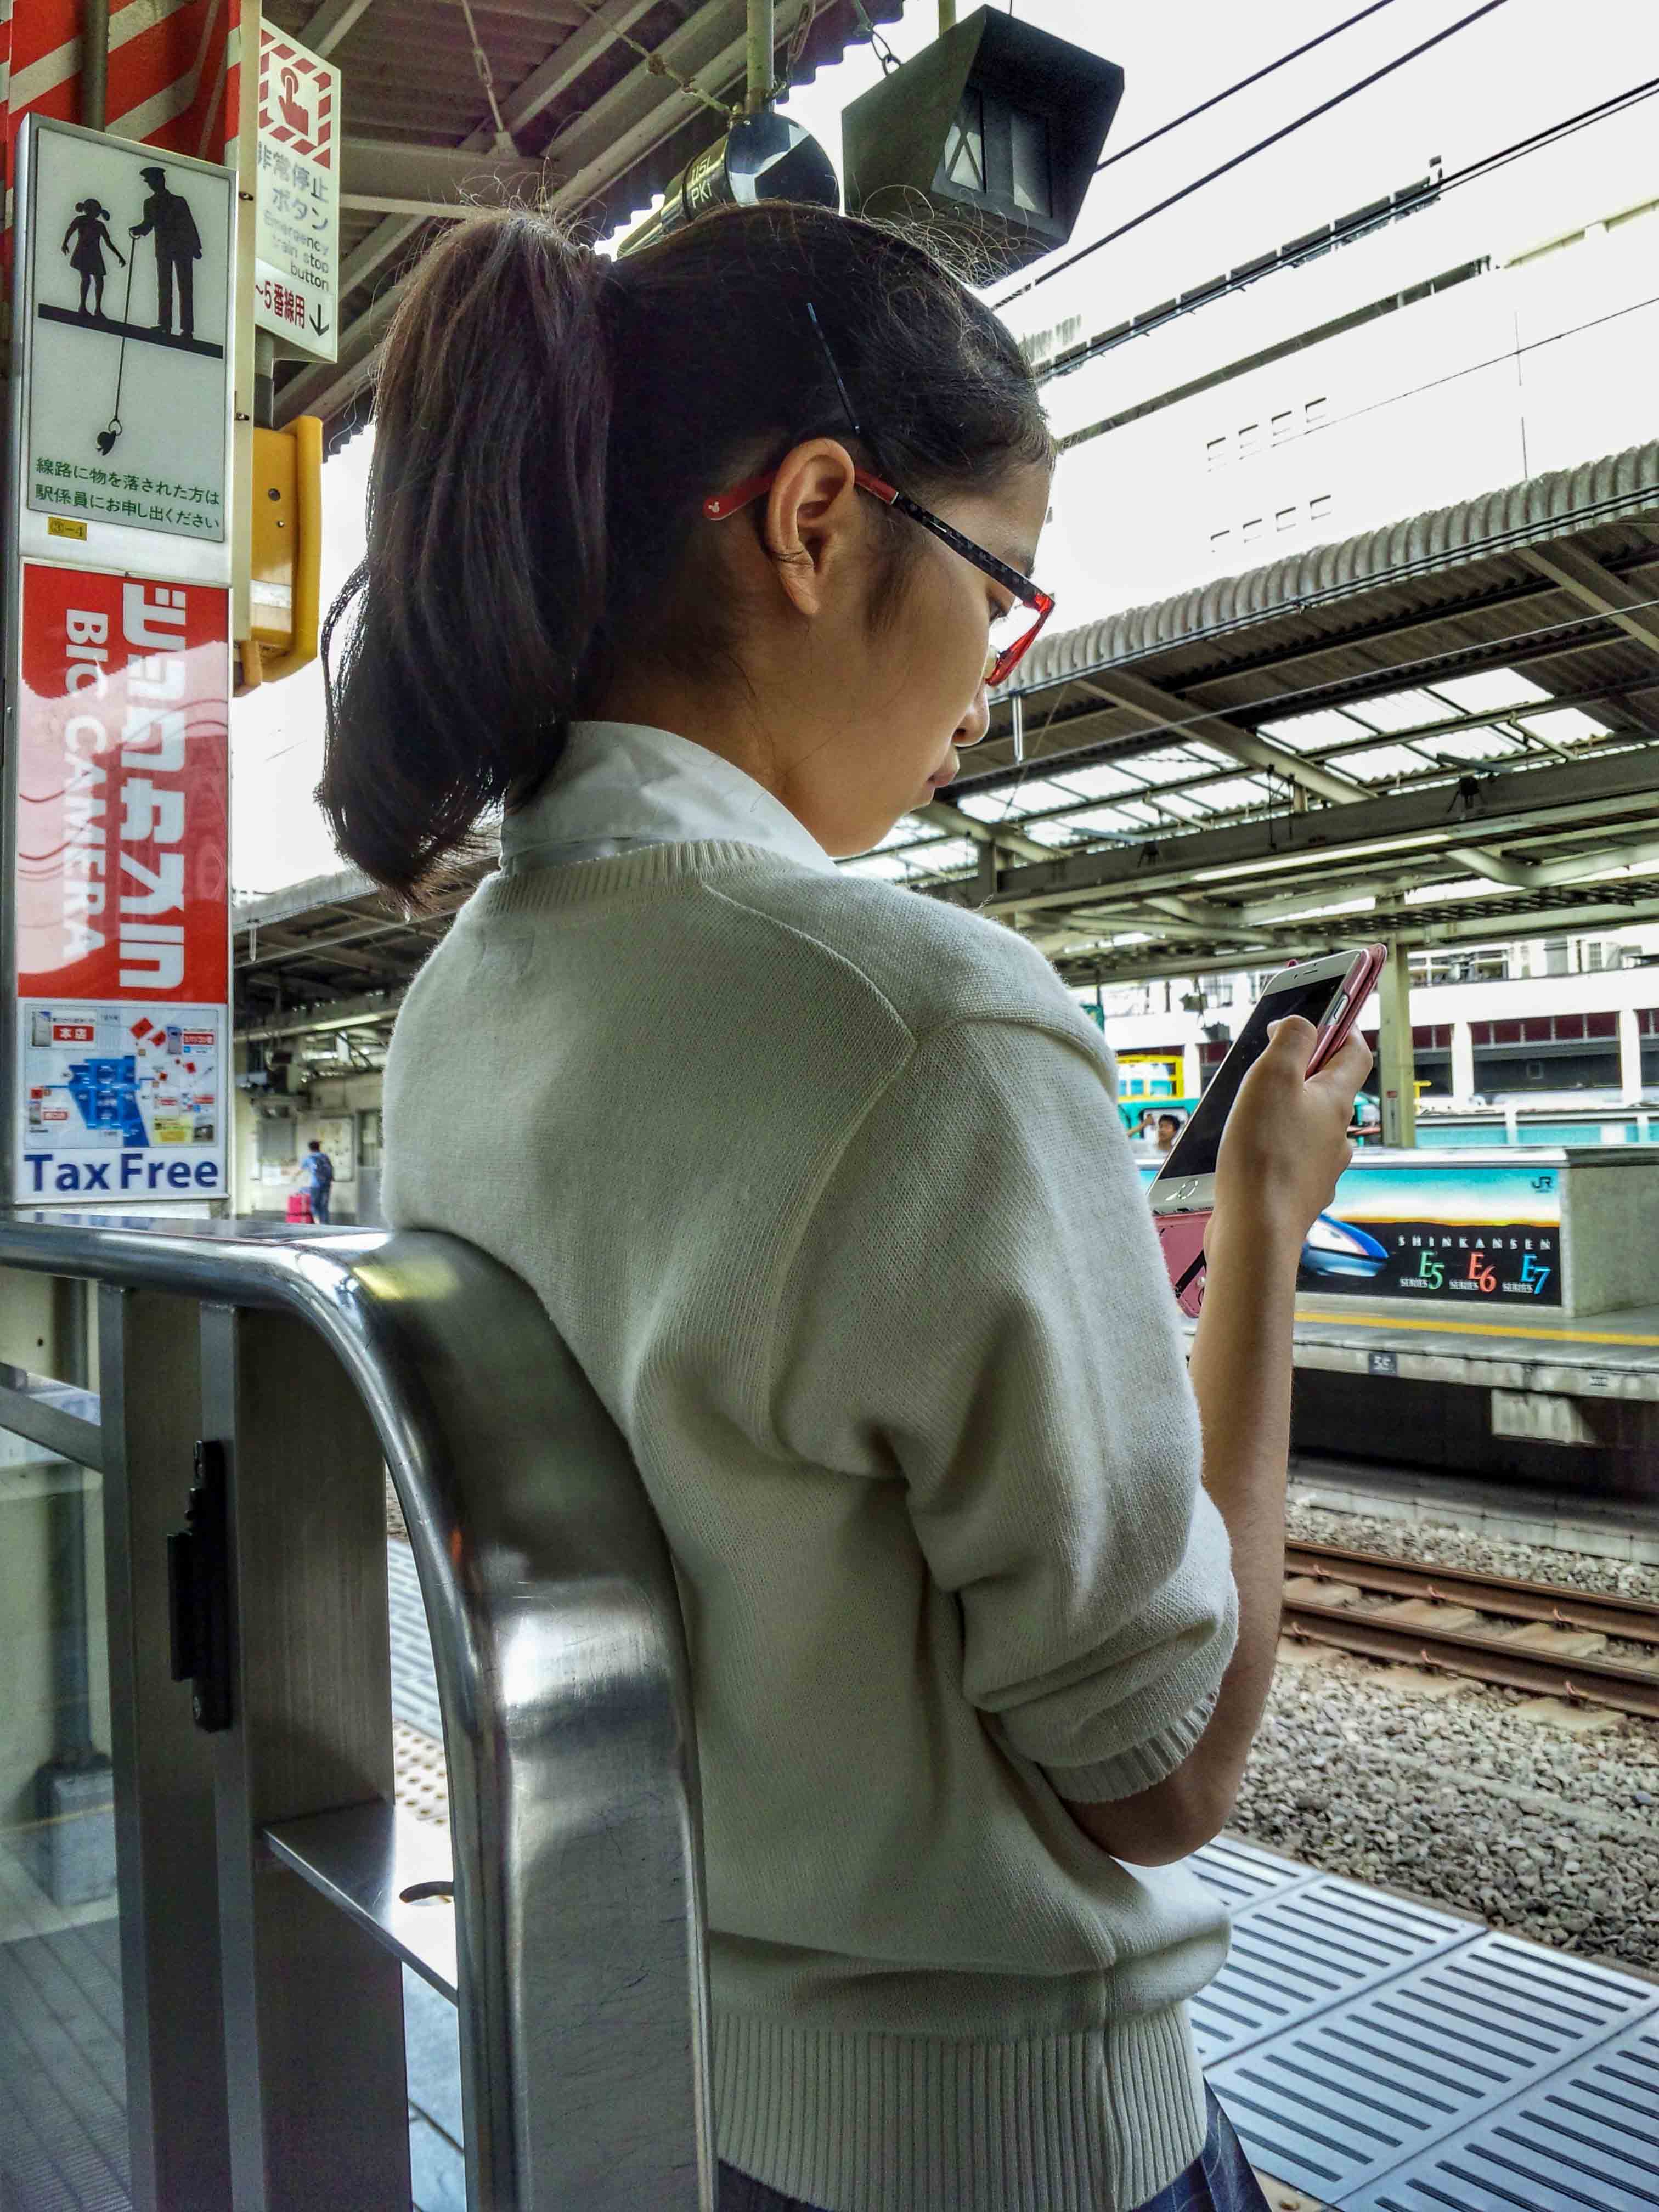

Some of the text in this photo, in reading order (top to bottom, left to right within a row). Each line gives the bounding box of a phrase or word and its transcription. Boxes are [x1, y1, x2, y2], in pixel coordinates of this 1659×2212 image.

[258, 141, 330, 203] 非常停止
[273, 188, 328, 230] ボタン
[291, 260, 329, 292] button
[303, 252, 329, 274] stop
[36, 456, 220, 506] 線路に物を落された方は
[35, 483, 219, 529] 駅係員にお申し出ください
[63, 608, 109, 958] BIC CAMERA
[119, 582, 187, 989] ビックカメラ
[24, 1153, 219, 1192] Tax Free
[1531, 1176, 1553, 1189] JR
[1398, 1235, 1551, 1251] SHINKANSEN
[1400, 1250, 1446, 1290] SERIES E5
[1449, 1251, 1497, 1293] SERIES E6
[1502, 1253, 1552, 1295] SERIES E7
